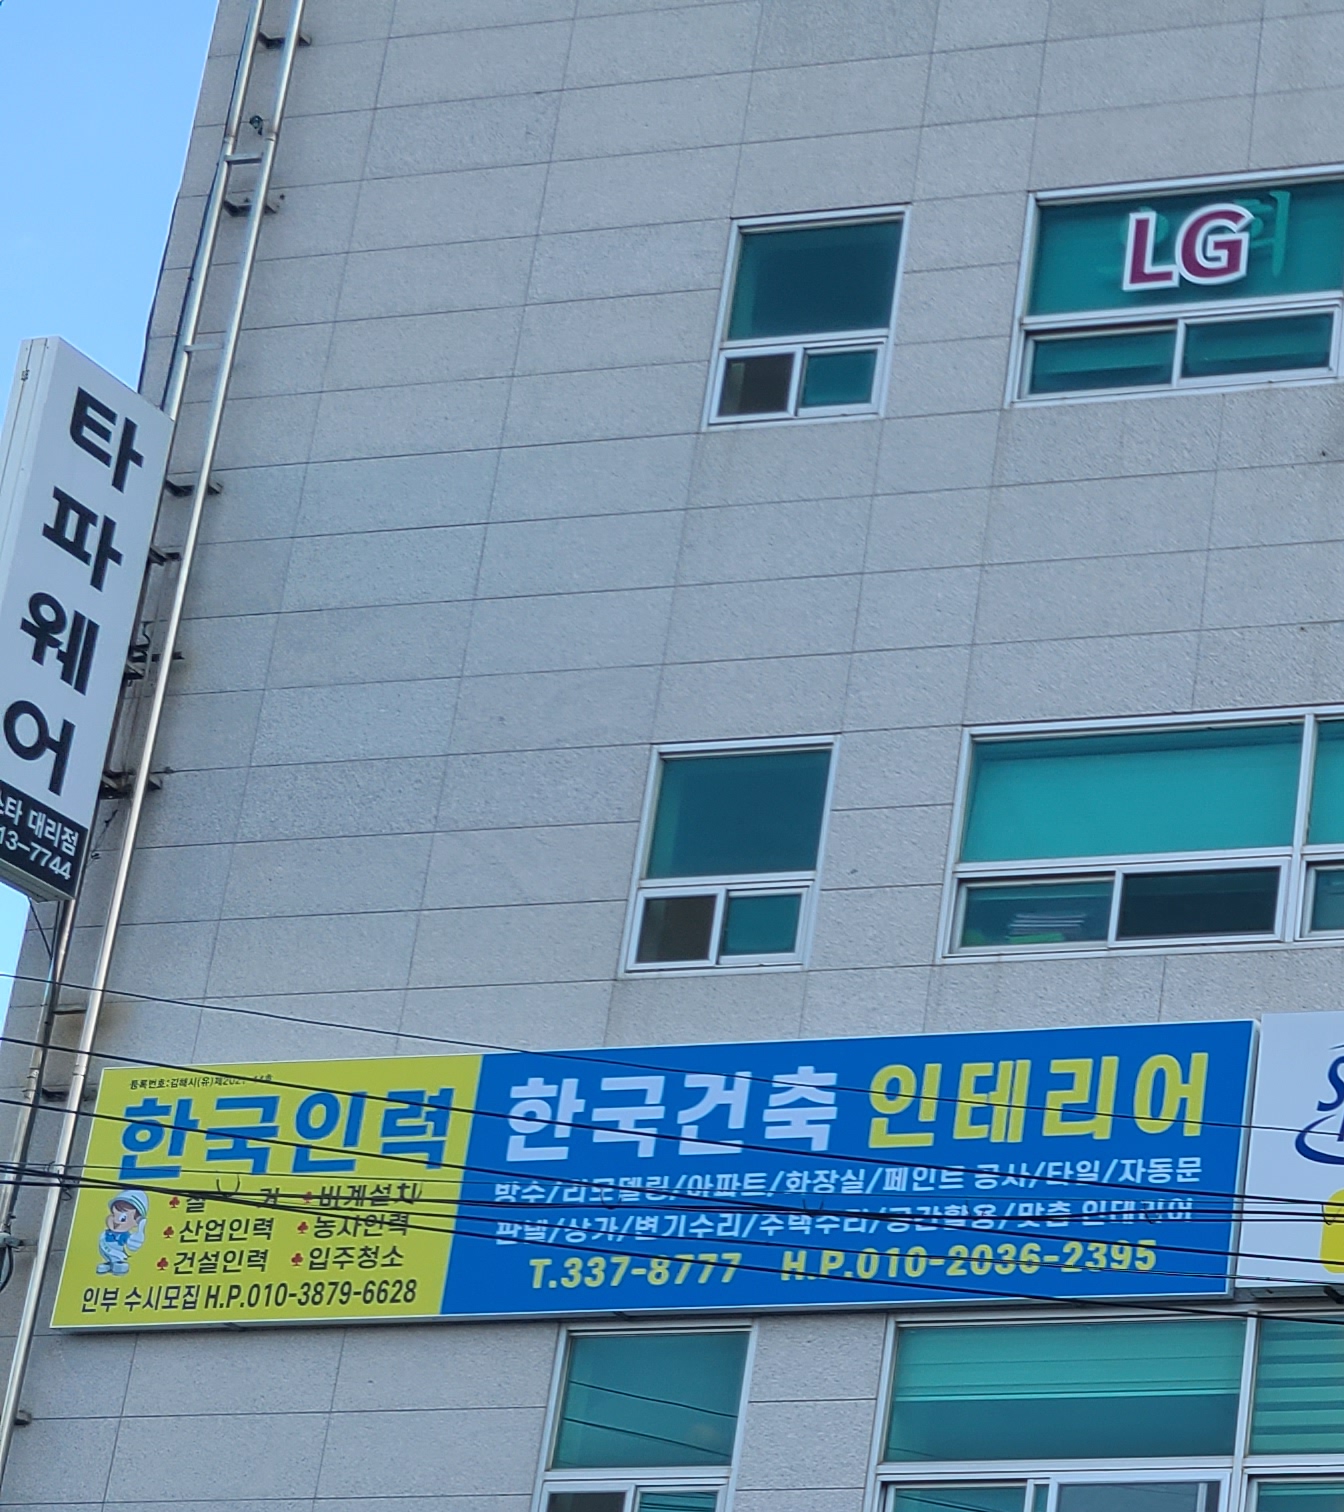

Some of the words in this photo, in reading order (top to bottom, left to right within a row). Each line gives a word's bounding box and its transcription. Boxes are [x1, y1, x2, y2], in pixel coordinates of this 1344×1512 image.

[1123, 203, 1254, 291] LG
[3, 387, 144, 796] 타파웨어
[28, 809, 79, 856] 대리점
[118, 1088, 455, 1180] 한국인력
[506, 1065, 838, 1162] 한국건축
[868, 1052, 1209, 1149] 인테리어
[179, 1217, 274, 1243] 산업인력
[173, 1249, 269, 1275] 건설인력
[309, 1245, 404, 1271] 입주청소
[81, 1287, 118, 1314] 인부
[123, 1284, 201, 1313] 수시모집
